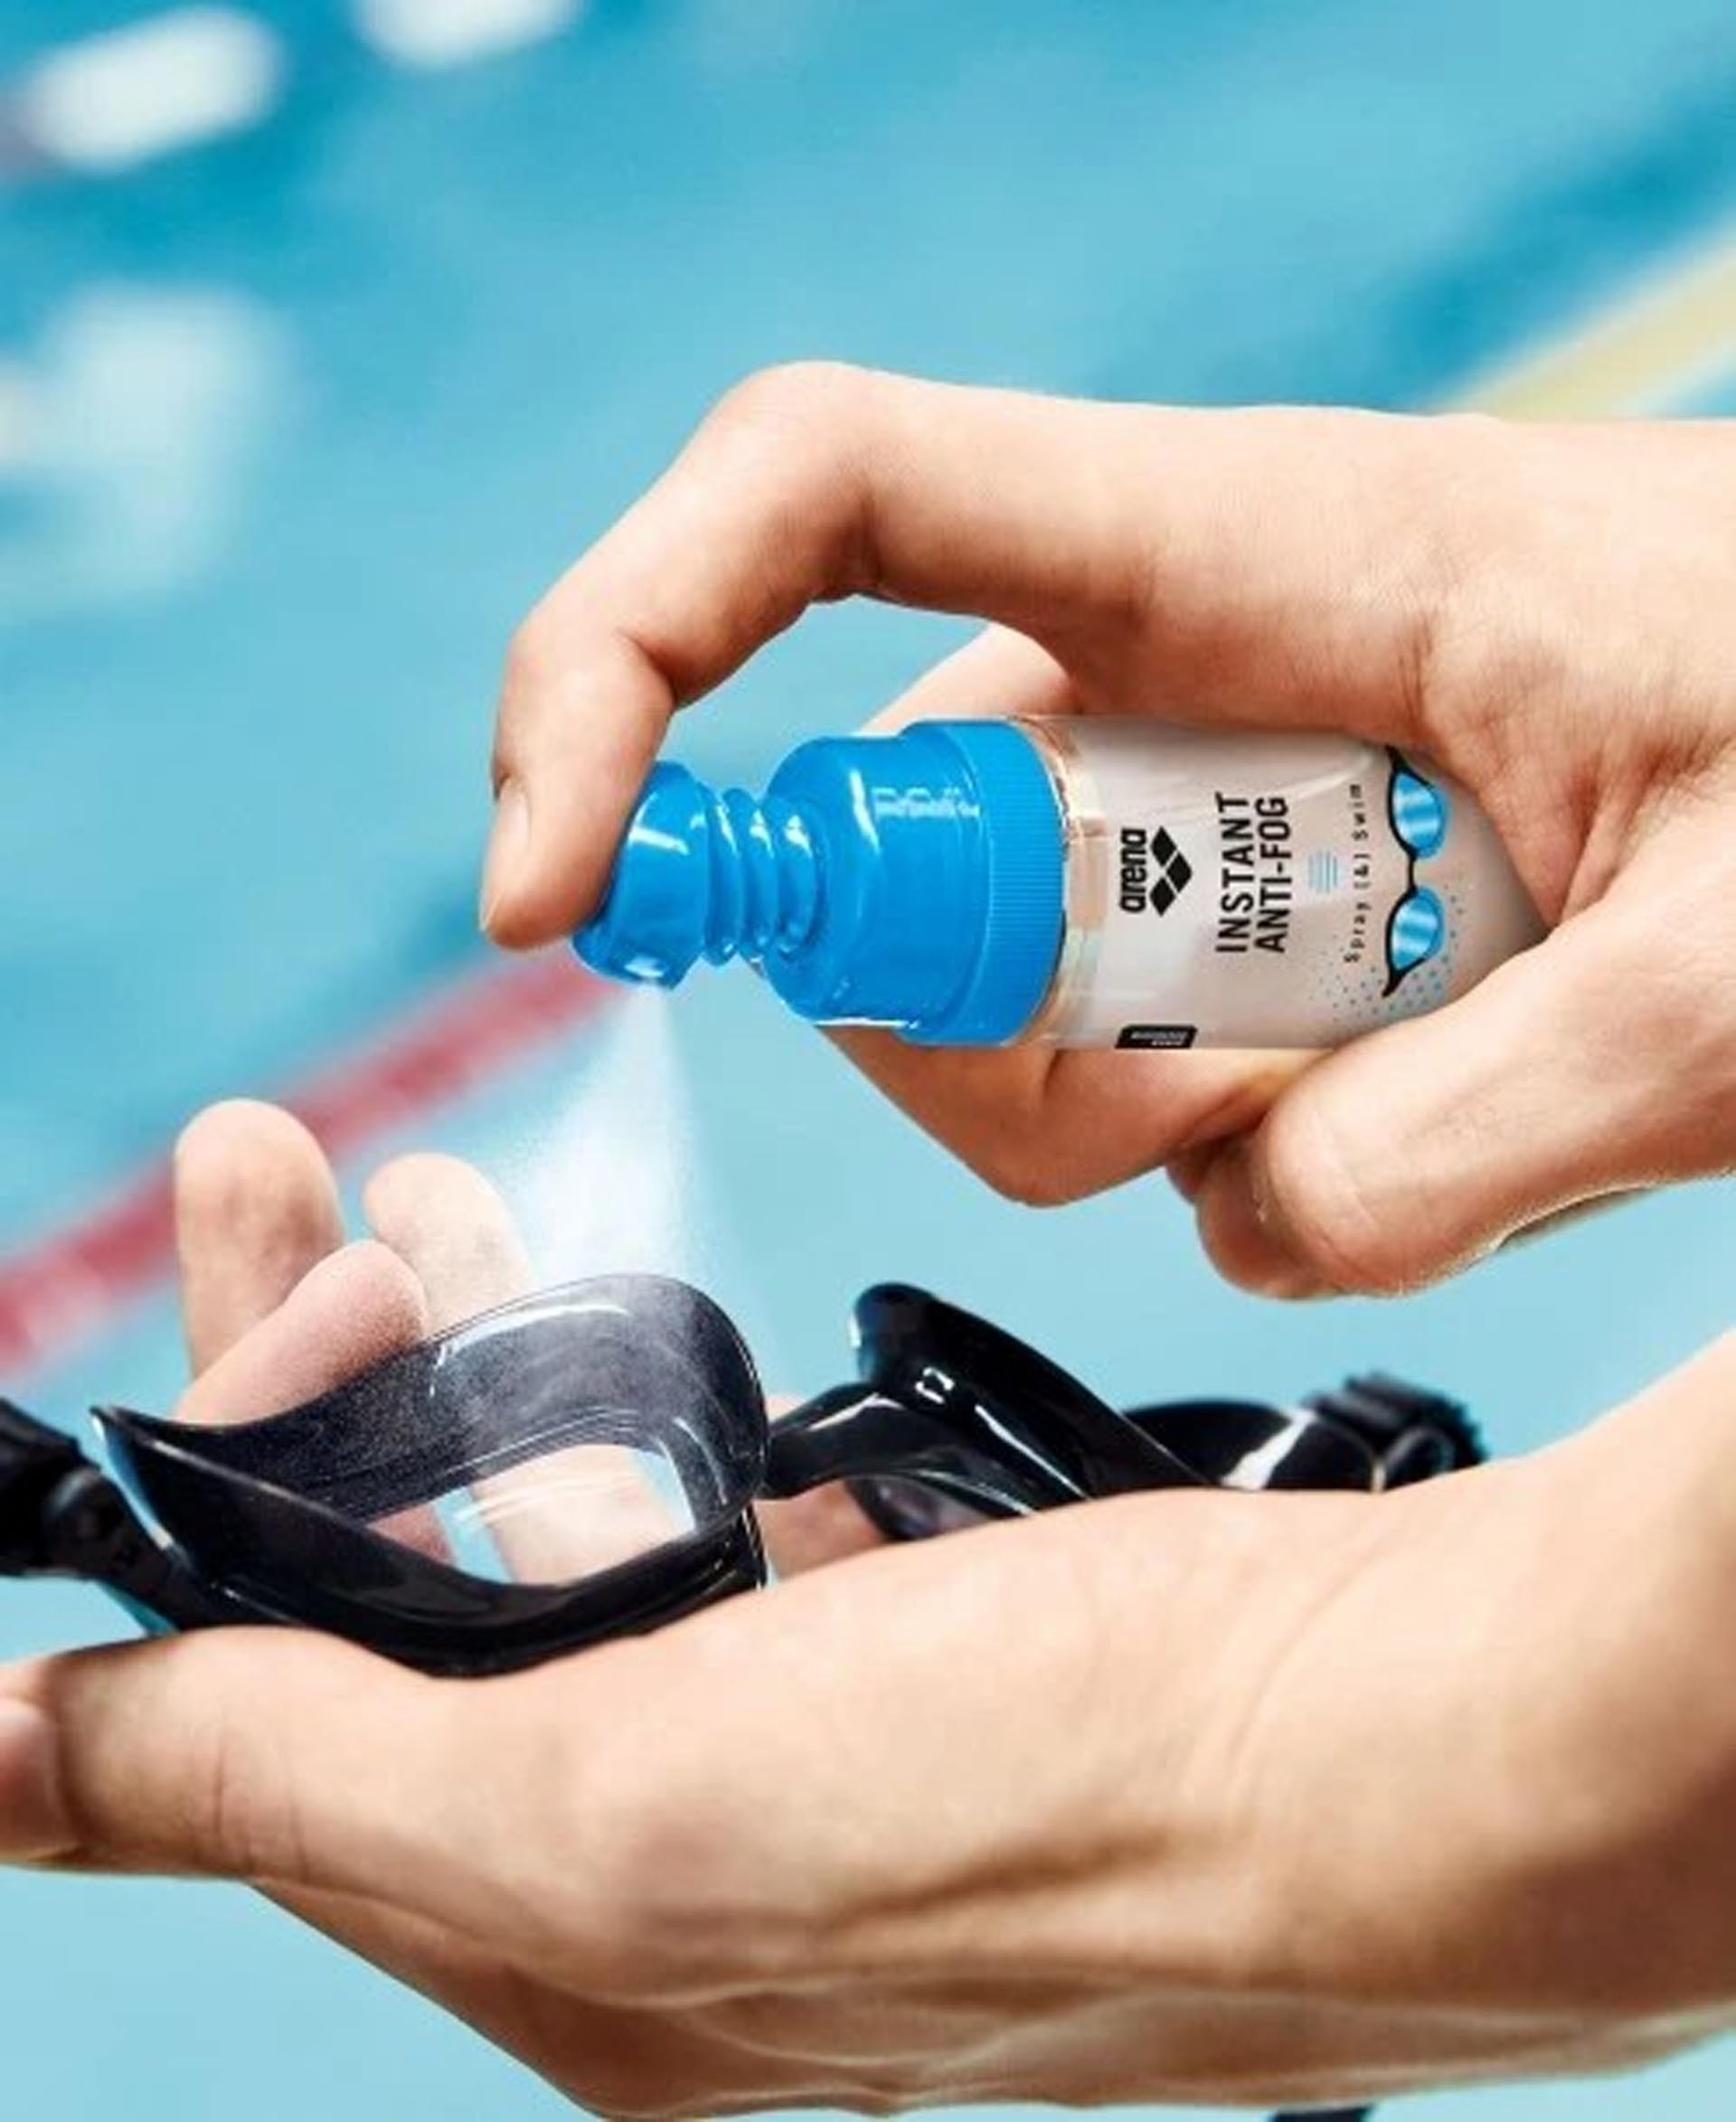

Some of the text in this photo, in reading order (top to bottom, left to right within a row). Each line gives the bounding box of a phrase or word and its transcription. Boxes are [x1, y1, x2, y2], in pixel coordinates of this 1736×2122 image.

[1350, 784, 1369, 841] Swim
[1119, 827, 1147, 913] arena
[1215, 791, 1255, 954] INSTANT
[1254, 797, 1292, 954] ANTI-FOG
[1344, 901, 1371, 963] Spray
